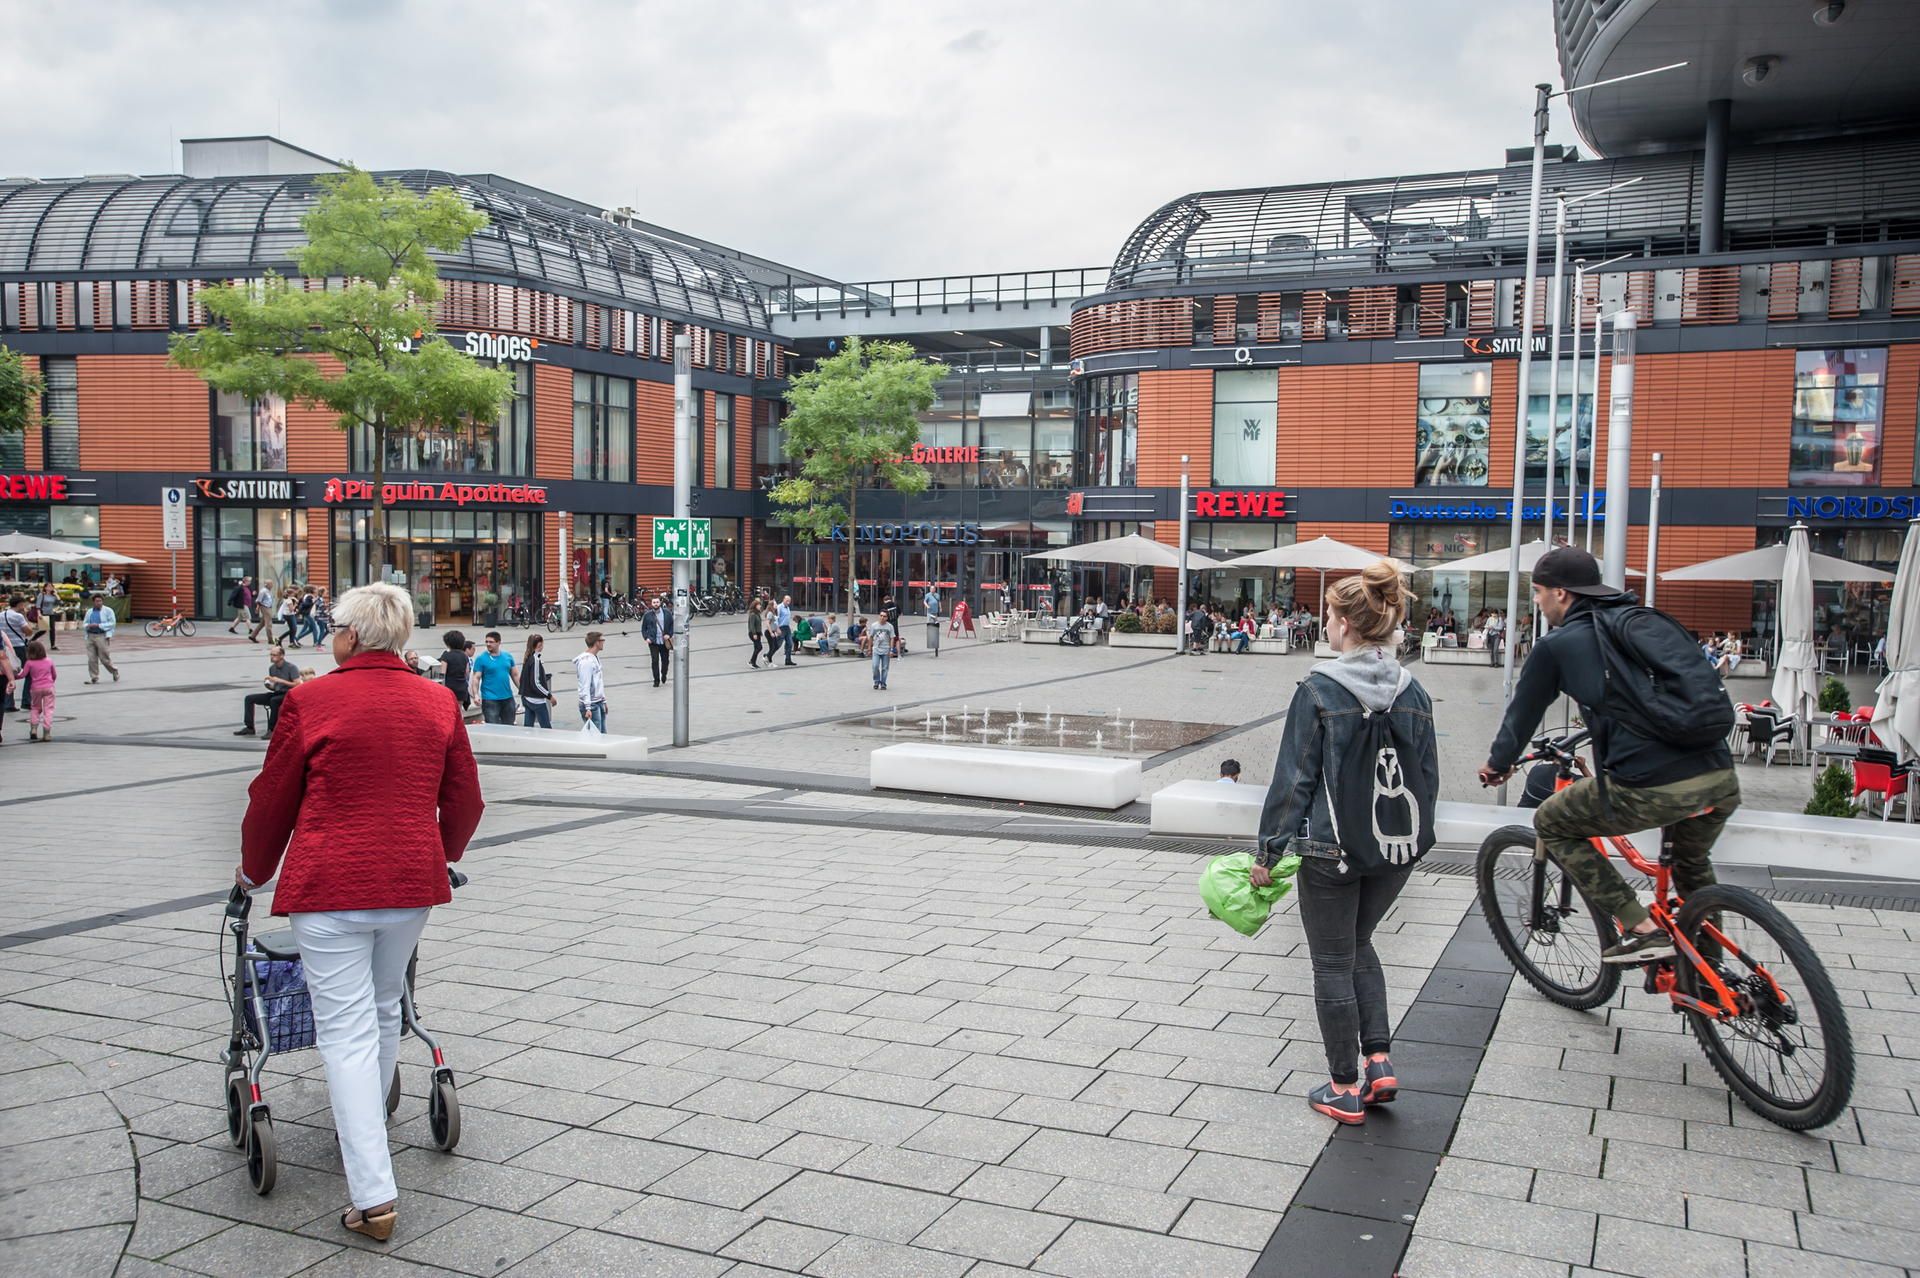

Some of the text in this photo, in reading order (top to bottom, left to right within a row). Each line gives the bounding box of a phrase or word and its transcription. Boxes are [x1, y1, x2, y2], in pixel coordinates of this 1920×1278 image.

[227, 480, 291, 500] SATURN
[439, 481, 547, 506] Apotheke
[1195, 491, 1286, 518] REWE
[1391, 501, 1498, 520] Deutsche
[831, 523, 979, 545] KNOPOLIS
